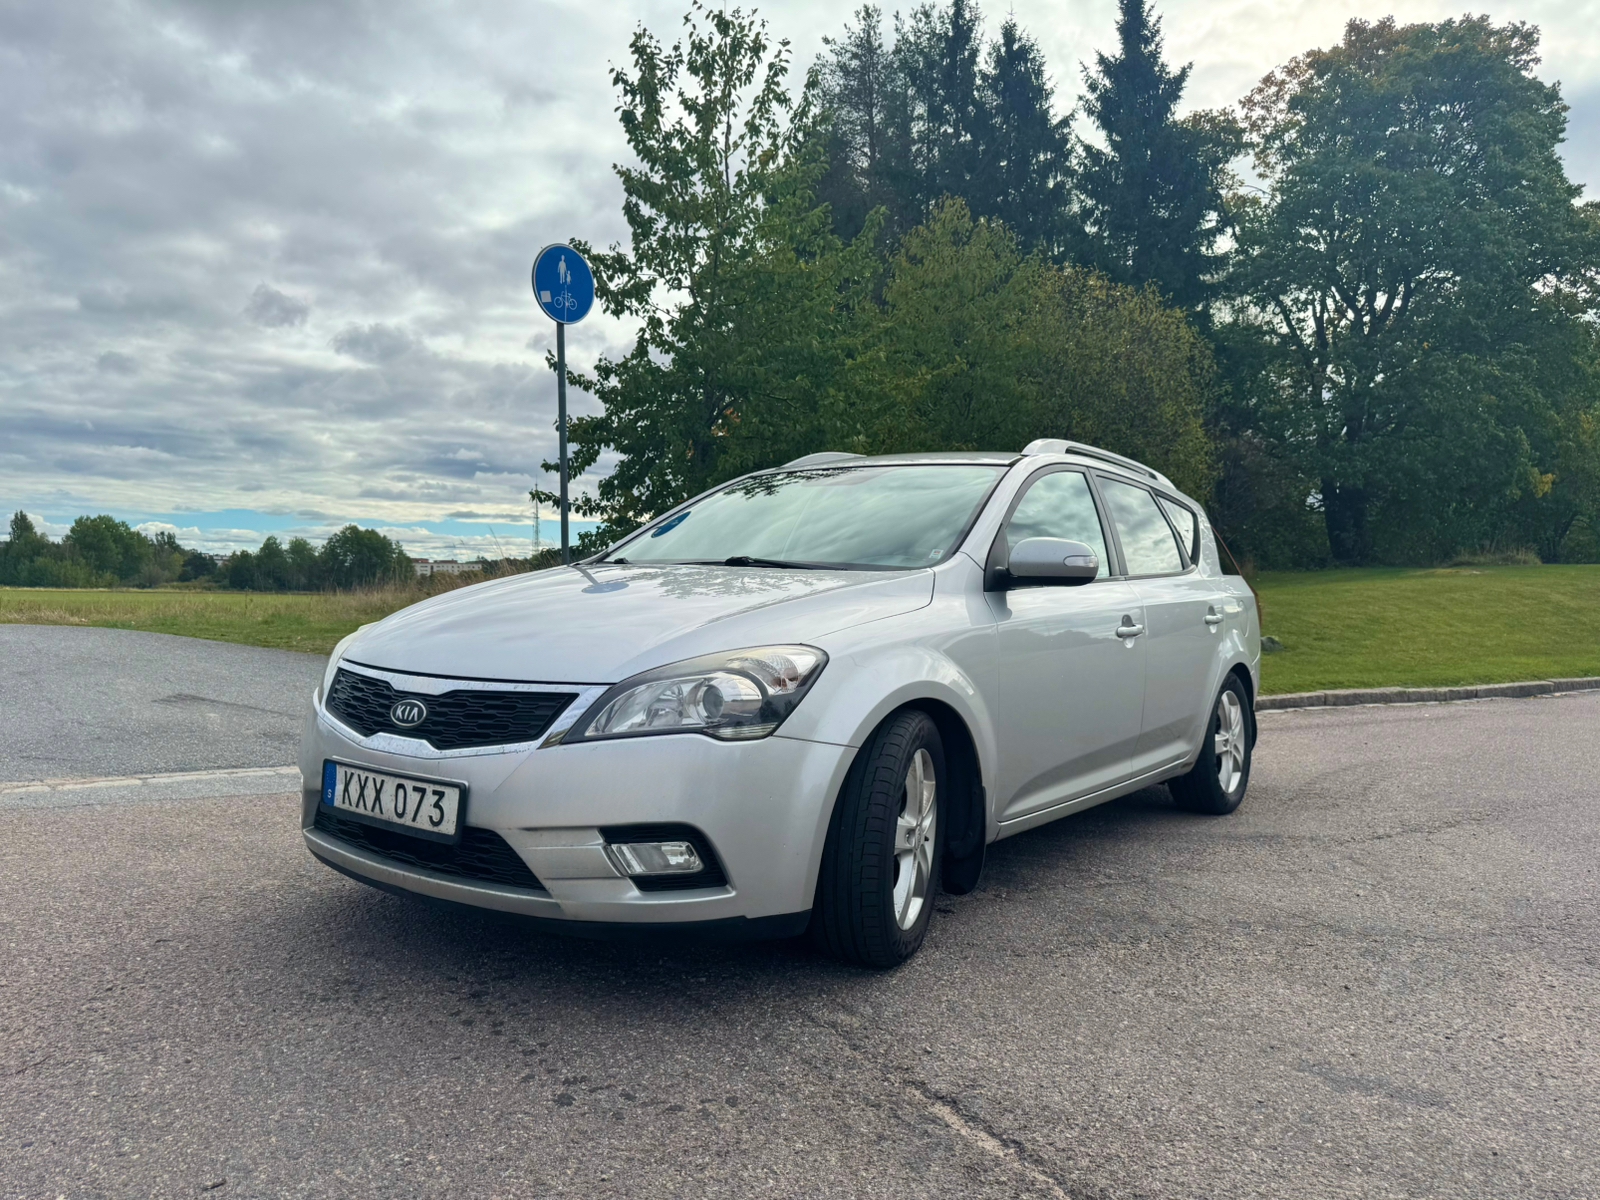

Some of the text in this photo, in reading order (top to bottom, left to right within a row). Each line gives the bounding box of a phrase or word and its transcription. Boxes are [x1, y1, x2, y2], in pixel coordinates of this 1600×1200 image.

[395, 705, 419, 721] KIA
[327, 789, 332, 799] S
[342, 770, 445, 827] KXX 073
